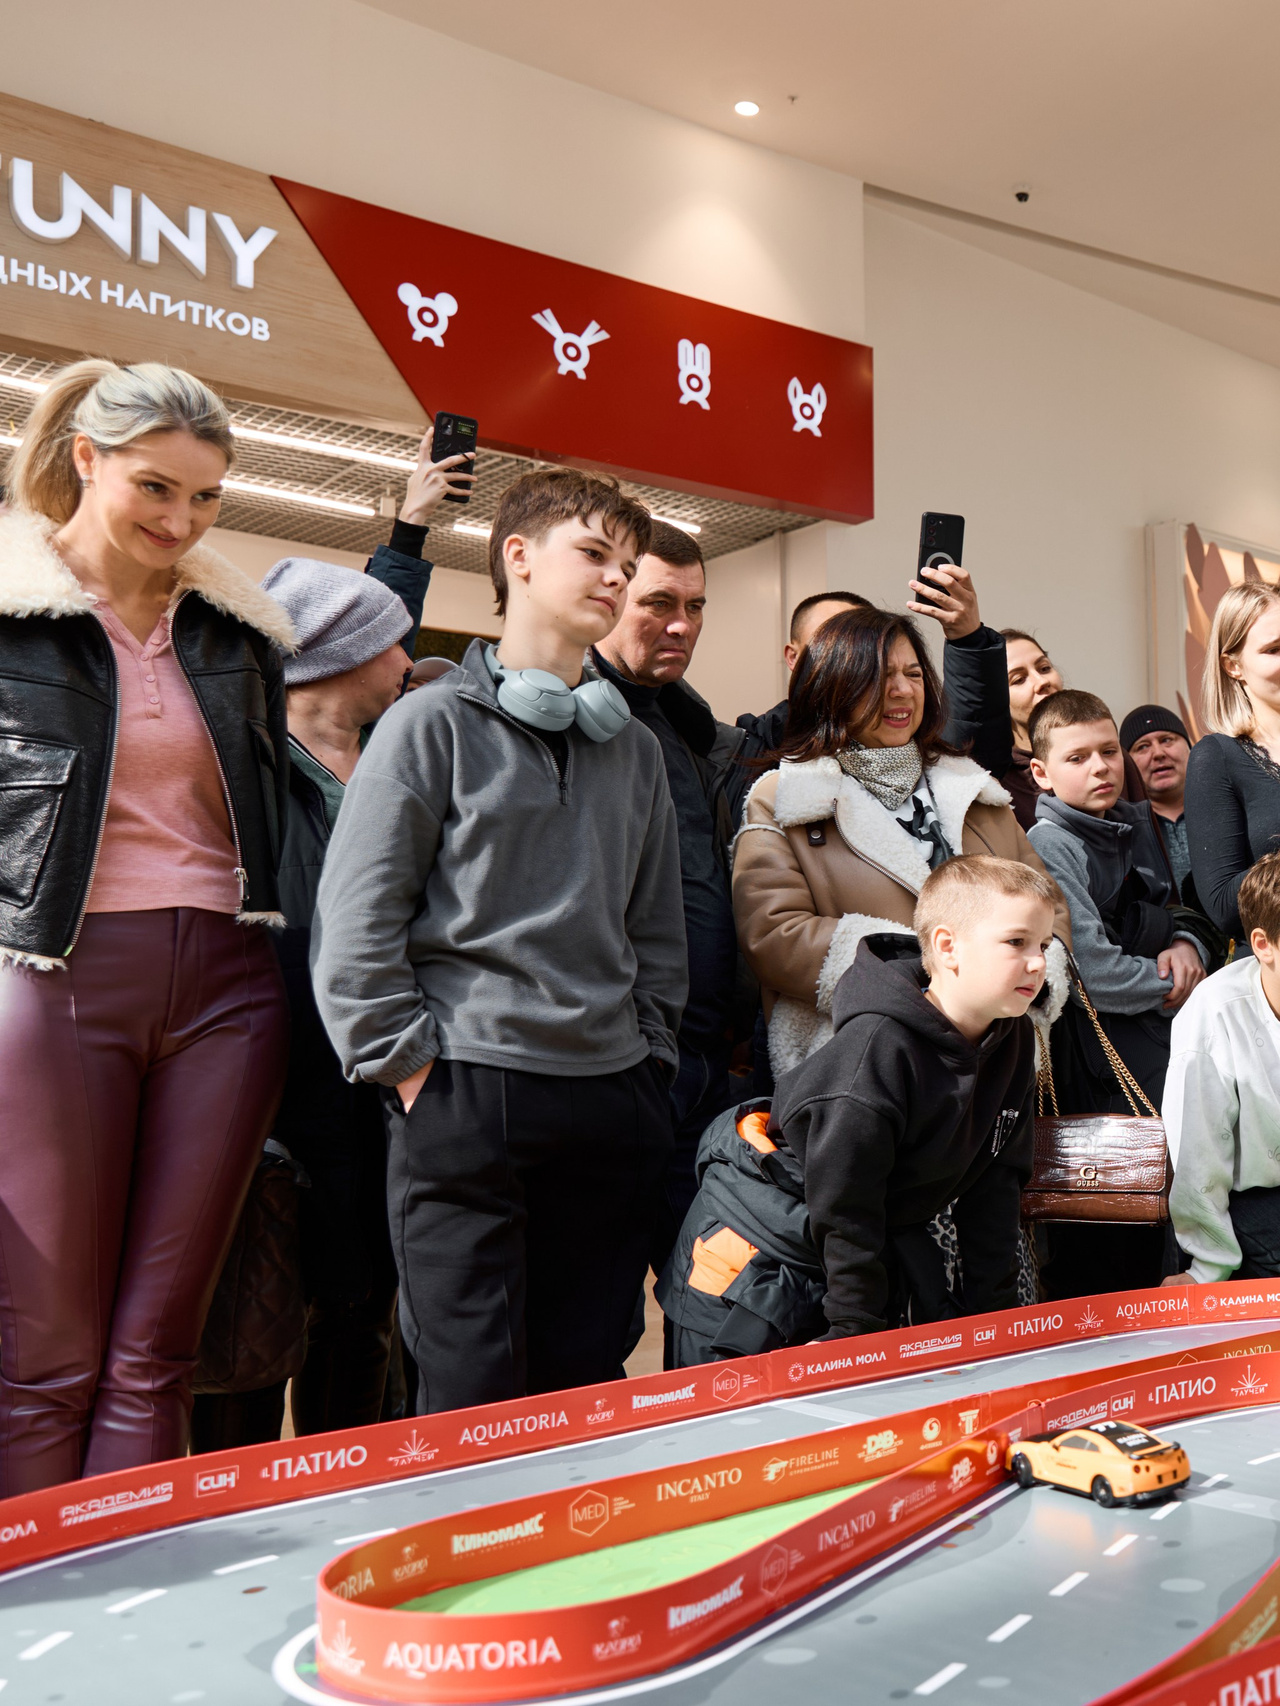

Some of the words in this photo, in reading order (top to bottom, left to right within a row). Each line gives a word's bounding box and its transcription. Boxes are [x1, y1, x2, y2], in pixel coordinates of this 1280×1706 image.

[0, 154, 279, 290] UNNY
[100, 279, 270, 341] НАПИТКОВ
[1116, 1298, 1188, 1319] AQUATORIA
[1220, 1294, 1264, 1306] КАЛИНА
[1014, 1314, 1063, 1336] ПАТИО
[899, 1333, 962, 1352] АКАДЕМИЯ
[807, 1356, 852, 1375] КАЛИНА
[856, 1352, 887, 1365] МОЛЛ
[632, 1383, 696, 1409] КИНОМАКС
[716, 1378, 737, 1391] MED
[1155, 1376, 1216, 1404] ПАТИО
[459, 1410, 569, 1446] AQUATORIA
[1047, 1401, 1107, 1430] АКАДЕМИЯ
[273, 1445, 367, 1481] ПАТИО
[789, 1448, 840, 1468] FIRELINE
[657, 1468, 742, 1501] INCANTO
[904, 1481, 937, 1506] FIRELINE
[60, 1481, 173, 1518] АКАДЕМИЯ
[574, 1503, 605, 1522] MED
[0, 1519, 38, 1542] ОЛЛ
[452, 1514, 543, 1555] КИНОМАКС
[818, 1510, 876, 1550] INCANTO
[668, 1576, 744, 1630] КИНОМАКС
[384, 1637, 562, 1679] AQUATORIA
